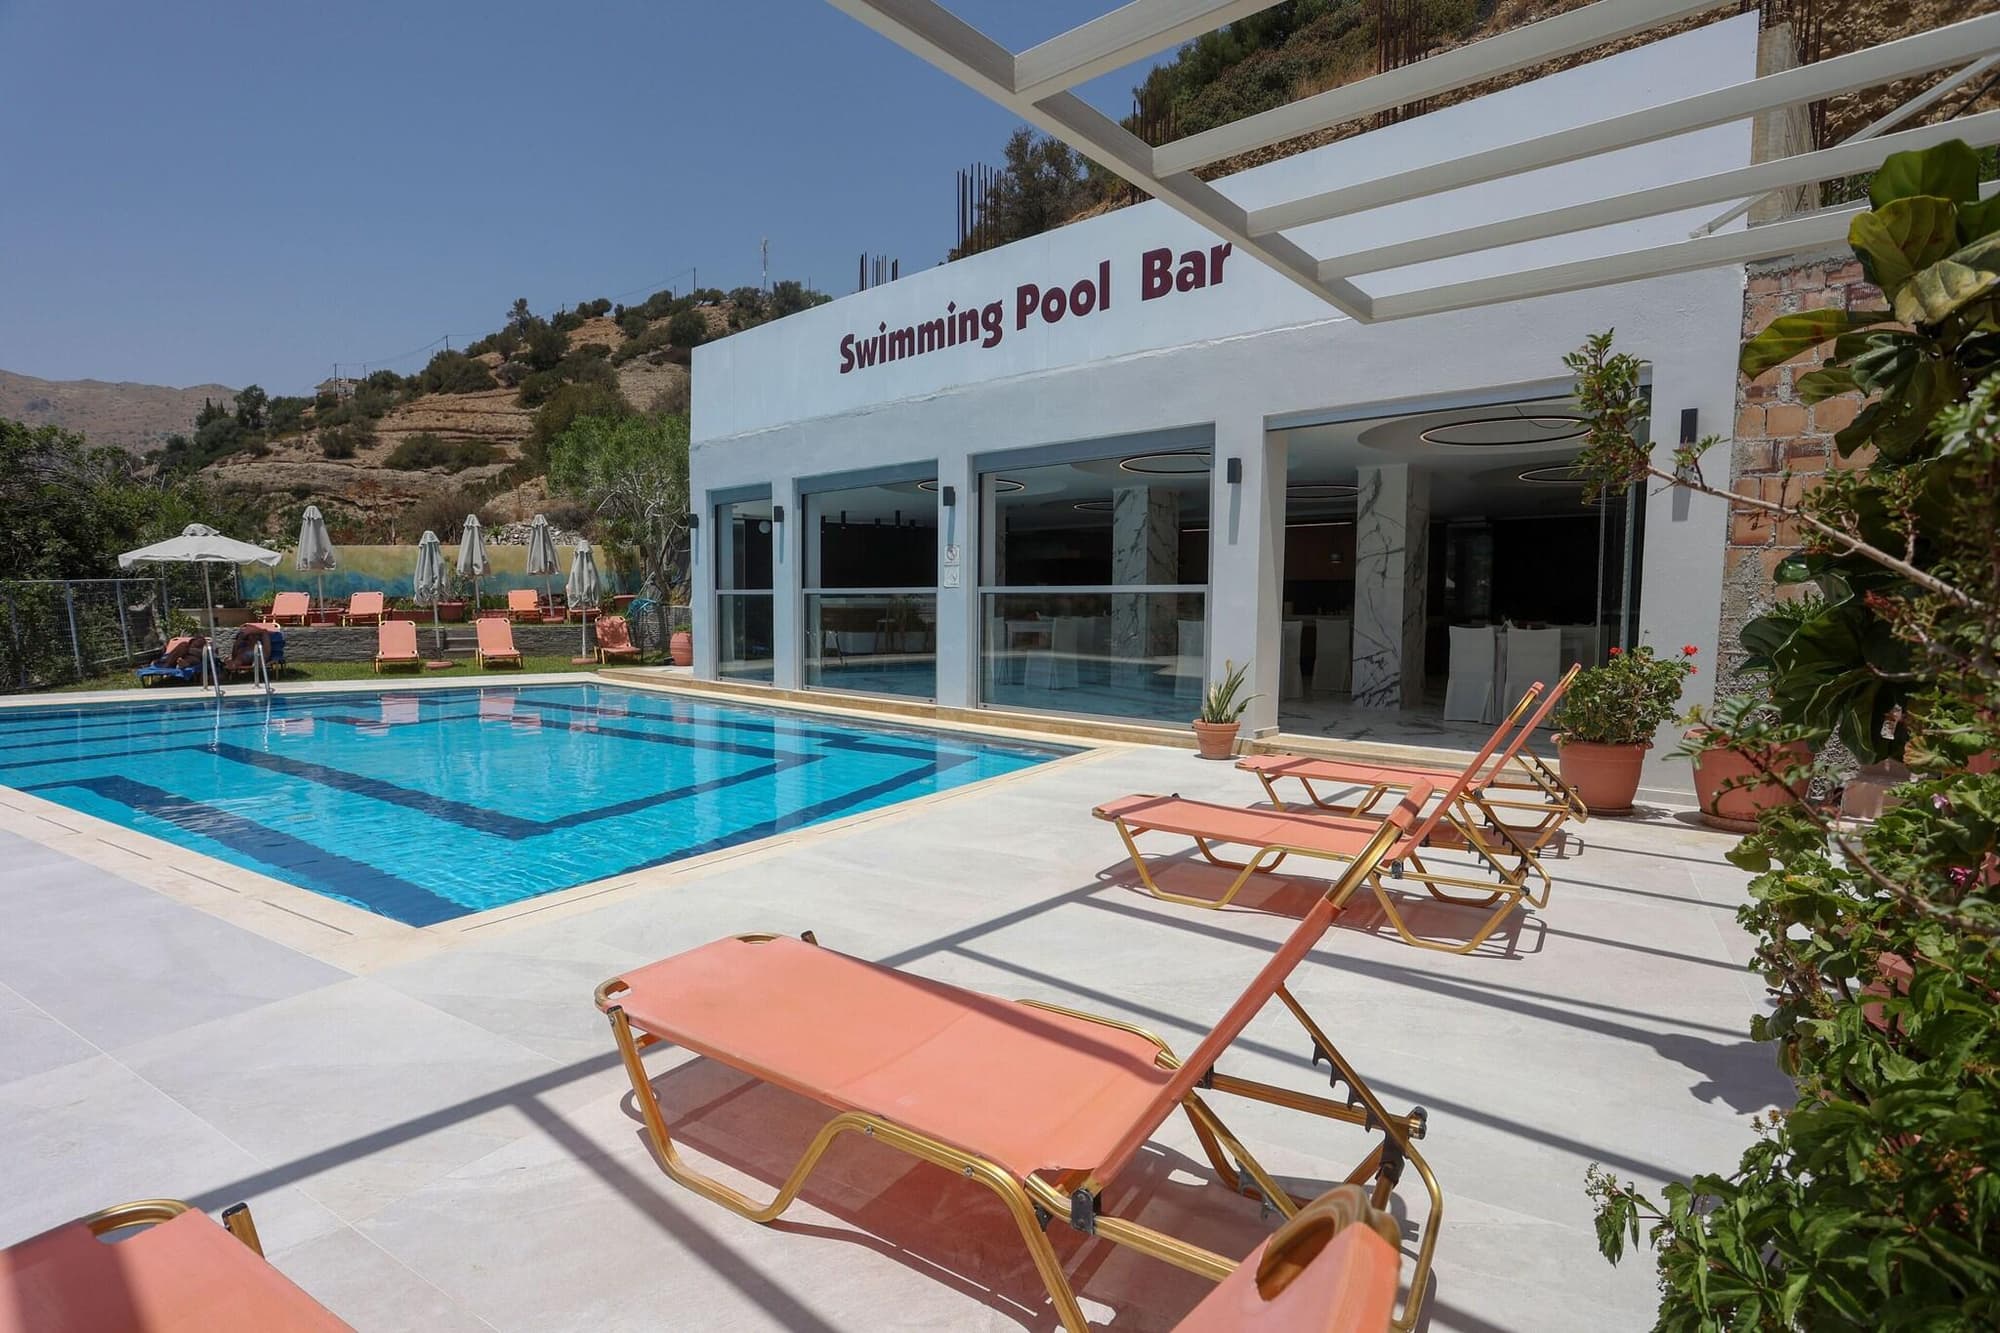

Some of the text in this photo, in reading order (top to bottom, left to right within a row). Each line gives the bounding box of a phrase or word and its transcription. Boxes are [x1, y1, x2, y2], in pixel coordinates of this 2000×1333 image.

[840, 242, 1232, 374] Swimming Pool Bar
